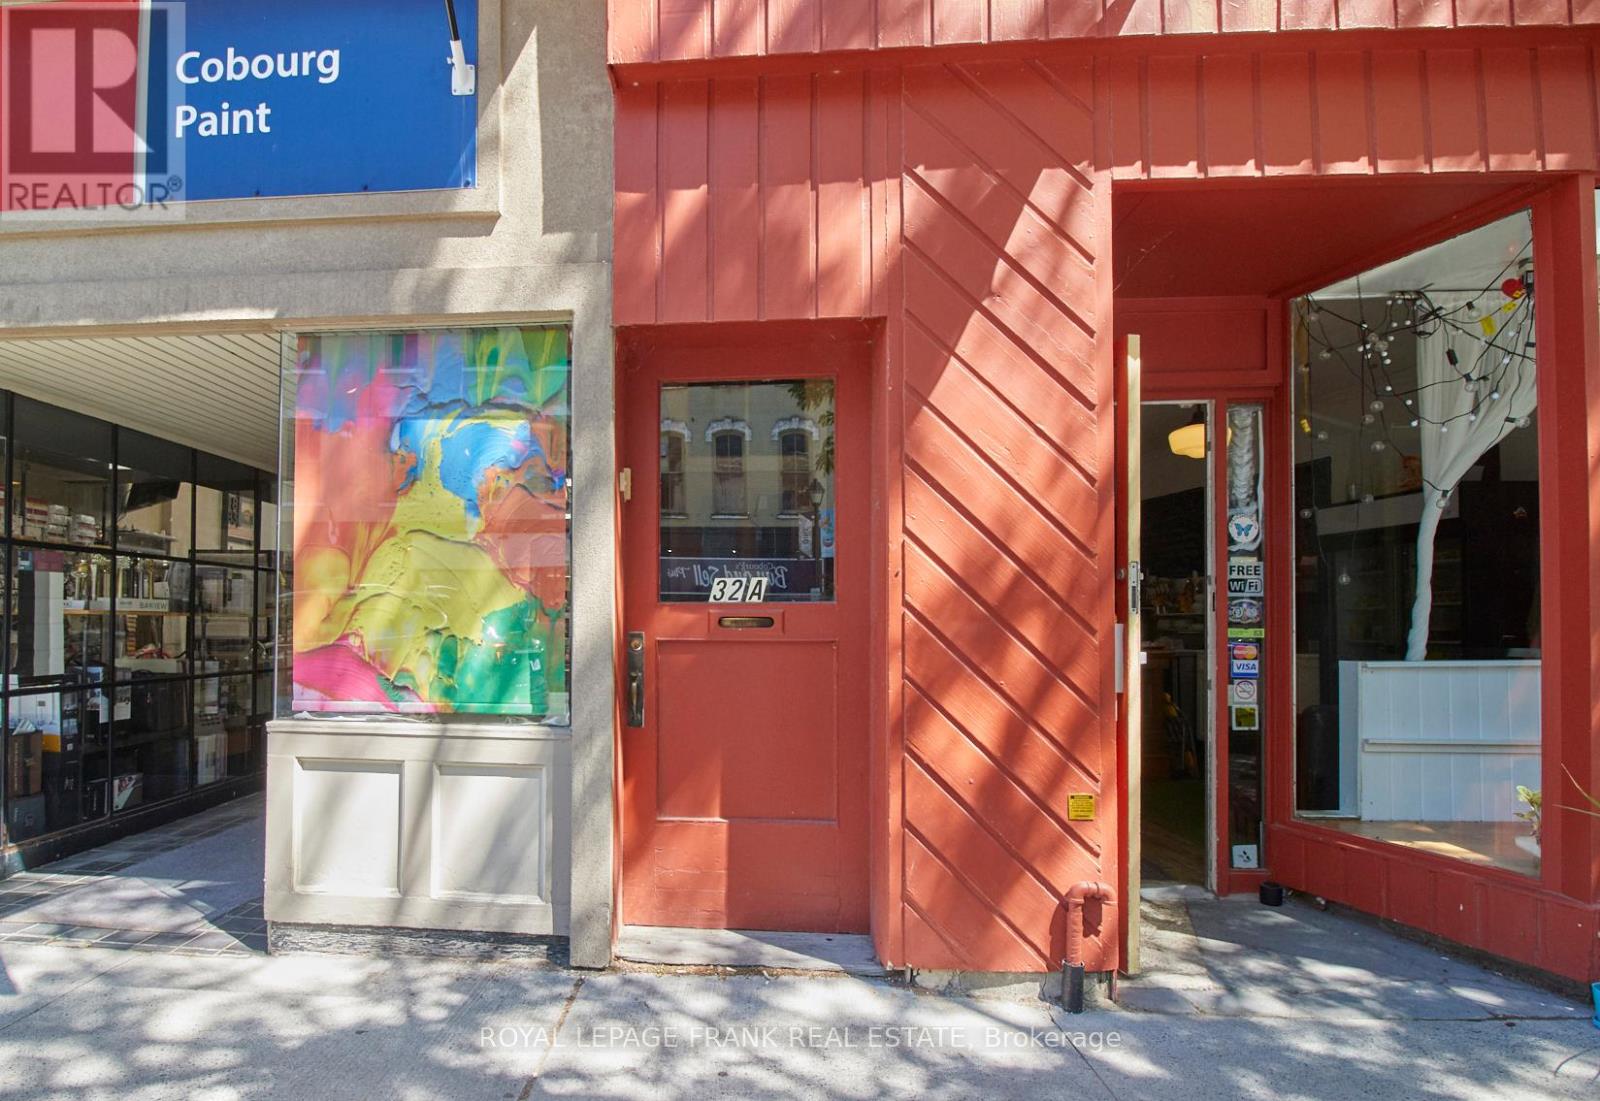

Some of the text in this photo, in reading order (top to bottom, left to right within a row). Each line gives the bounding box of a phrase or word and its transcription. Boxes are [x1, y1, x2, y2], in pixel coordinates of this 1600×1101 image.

[176, 47, 340, 84] Cobourg
[175, 102, 271, 138] Paint
[1229, 565, 1261, 576] FREE
[1235, 663, 1257, 671] VISA
